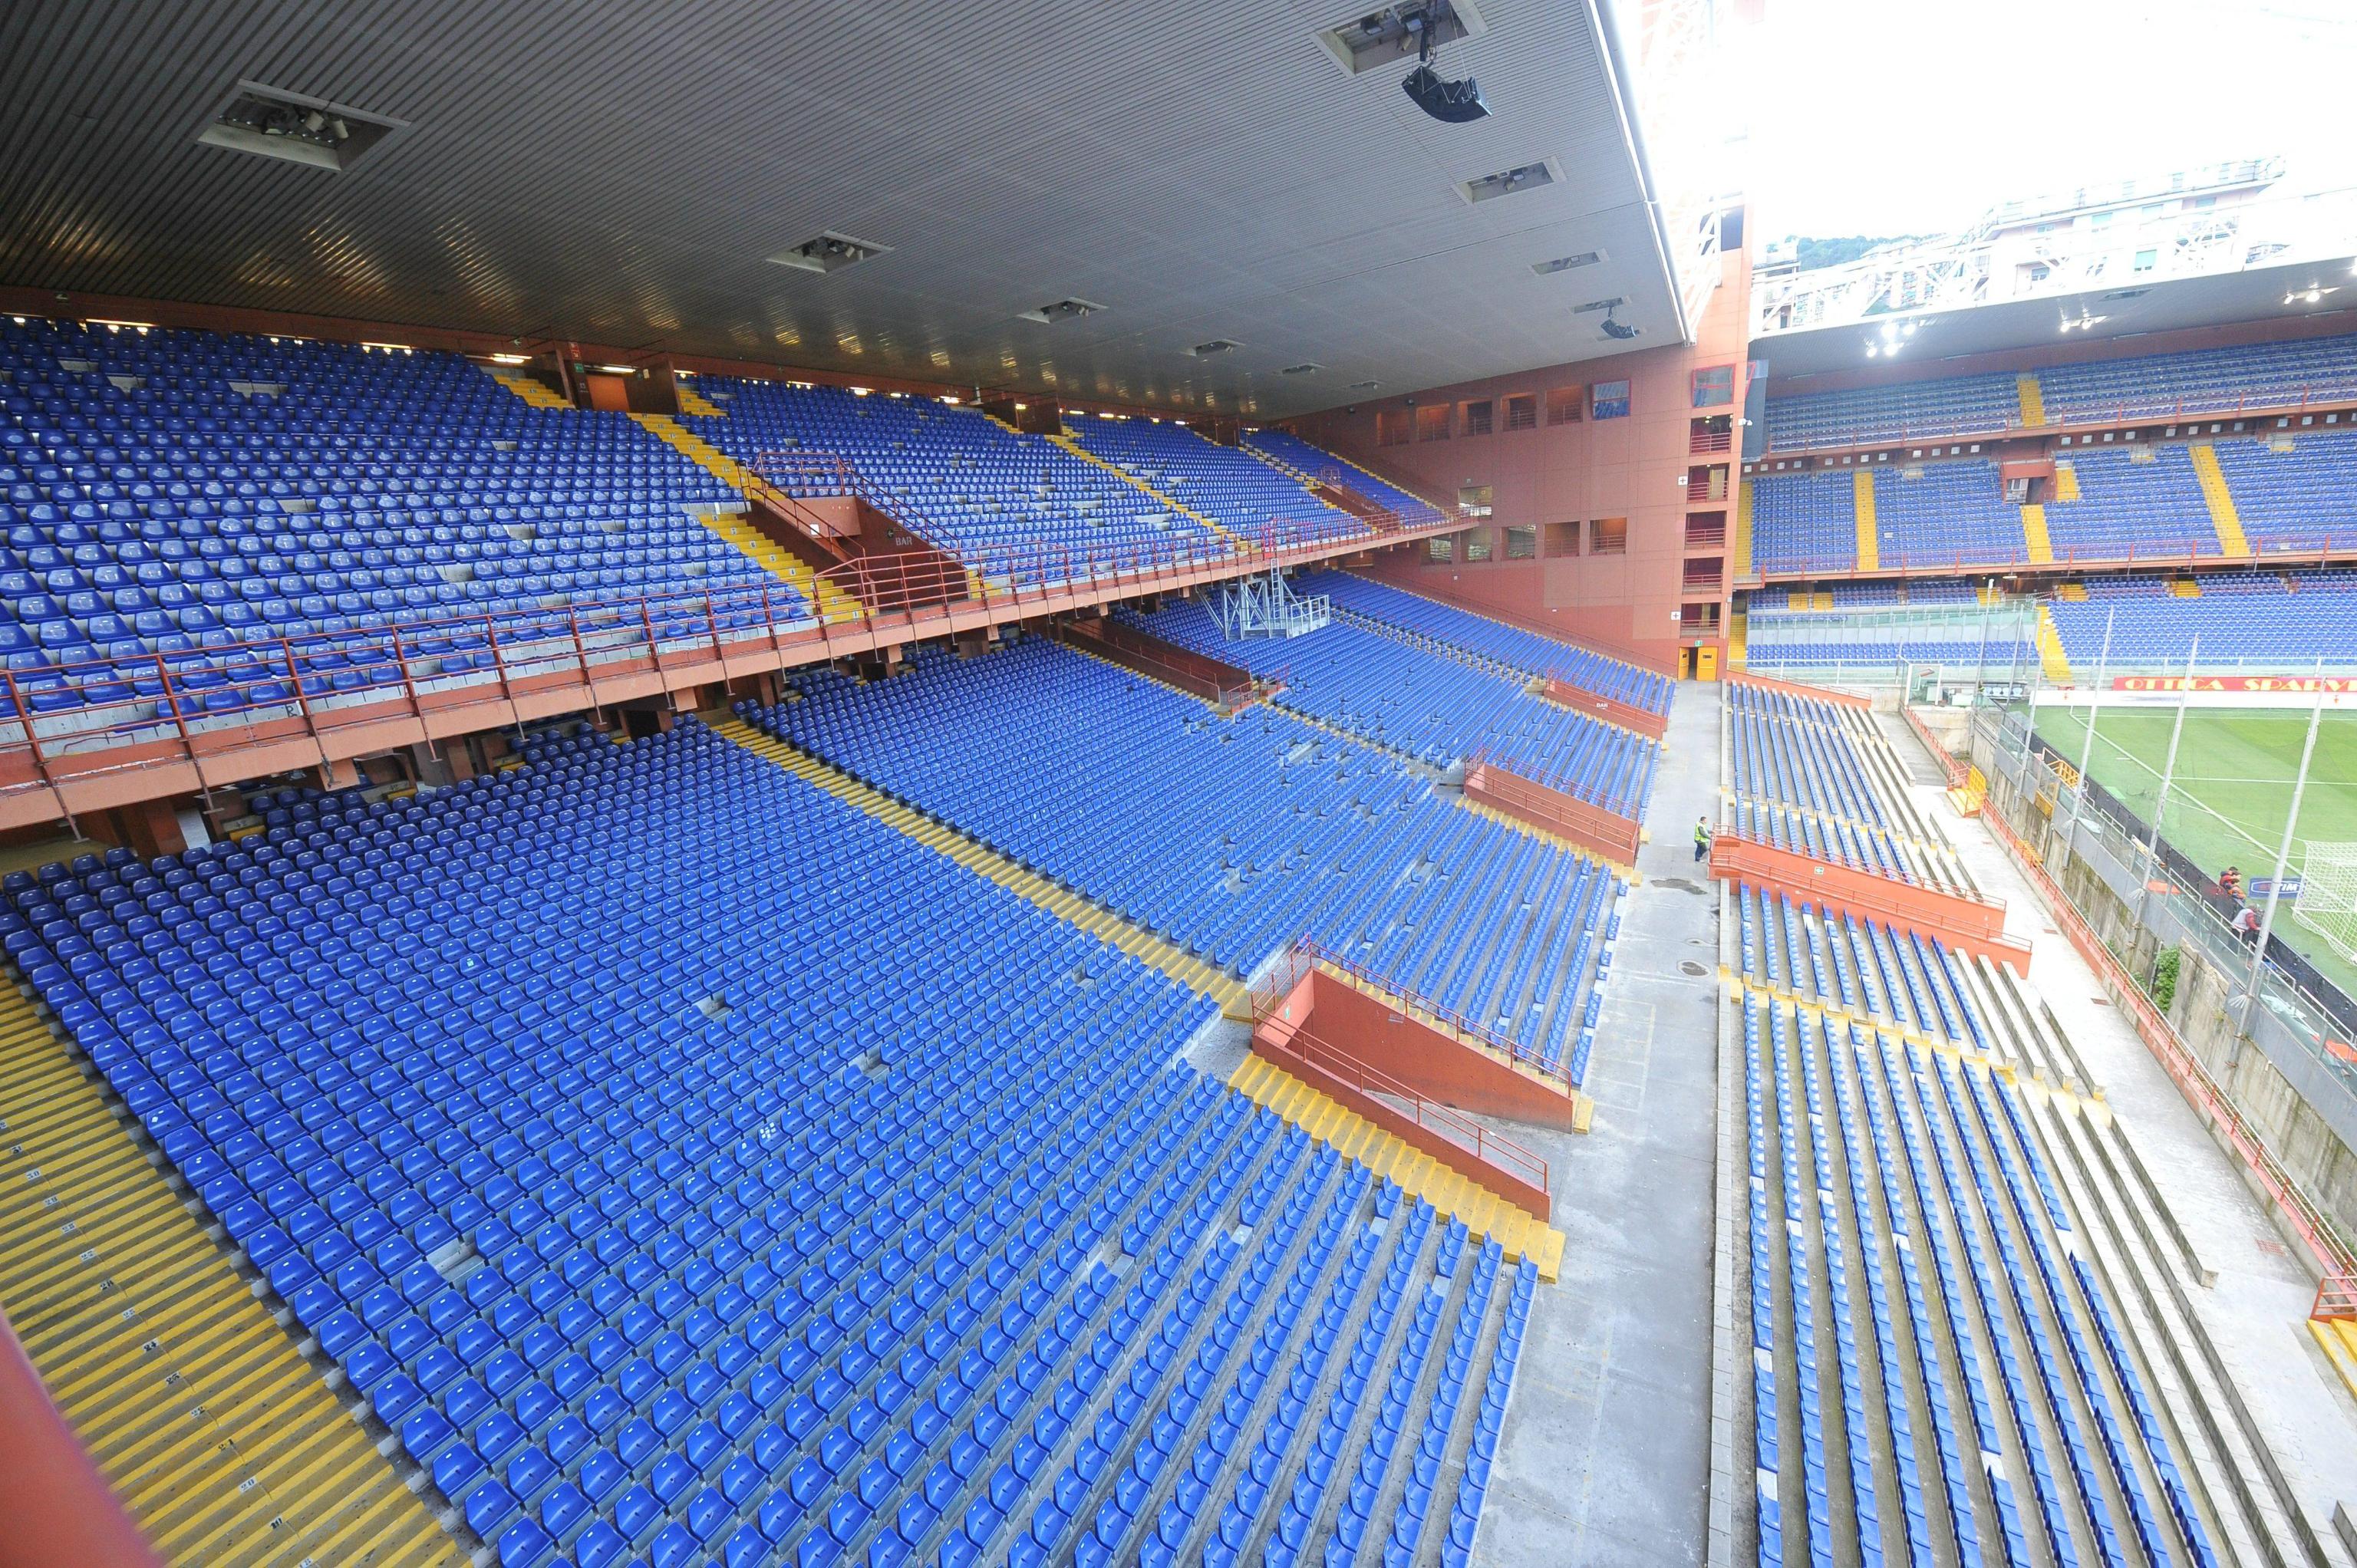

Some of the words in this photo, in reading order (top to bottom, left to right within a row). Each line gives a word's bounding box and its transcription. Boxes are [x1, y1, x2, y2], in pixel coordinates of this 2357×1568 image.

[896, 536, 913, 546] BAR
[2125, 678, 2225, 690] OTTICA
[241, 1477, 255, 1491] 20
